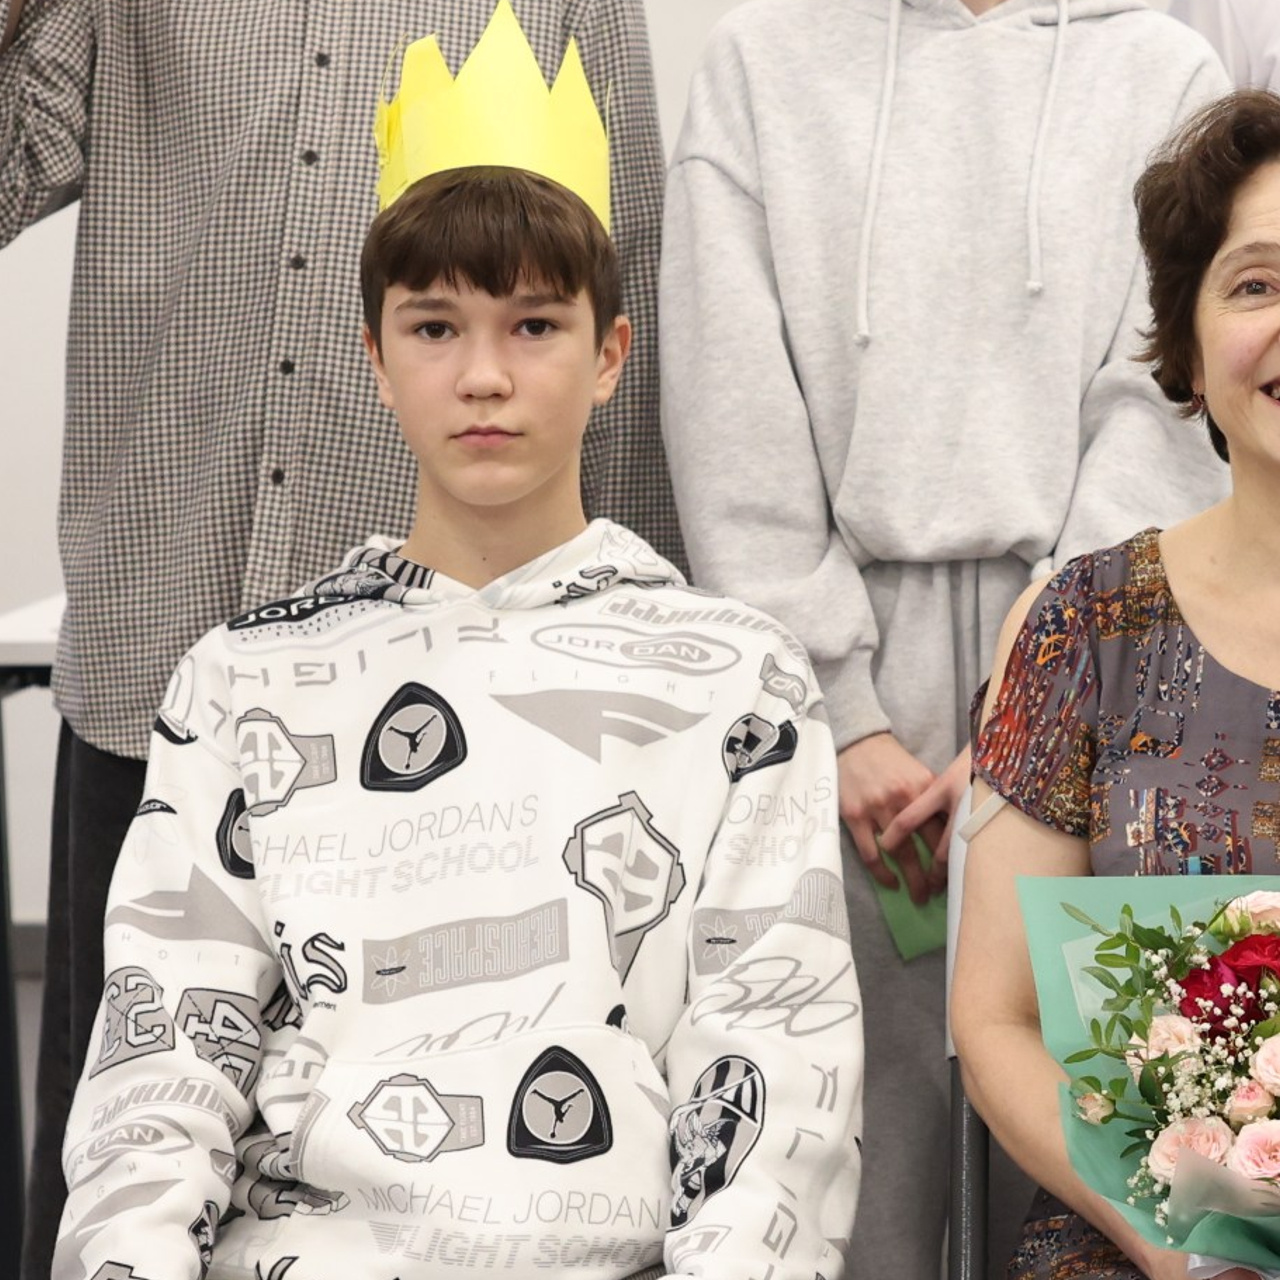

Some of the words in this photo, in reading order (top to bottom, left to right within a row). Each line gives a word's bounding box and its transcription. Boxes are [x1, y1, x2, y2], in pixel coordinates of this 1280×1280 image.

[391, 835, 539, 894] SCHOOL
[358, 1181, 501, 1224] MICHAEL
[513, 1189, 661, 1230] JORDAN
